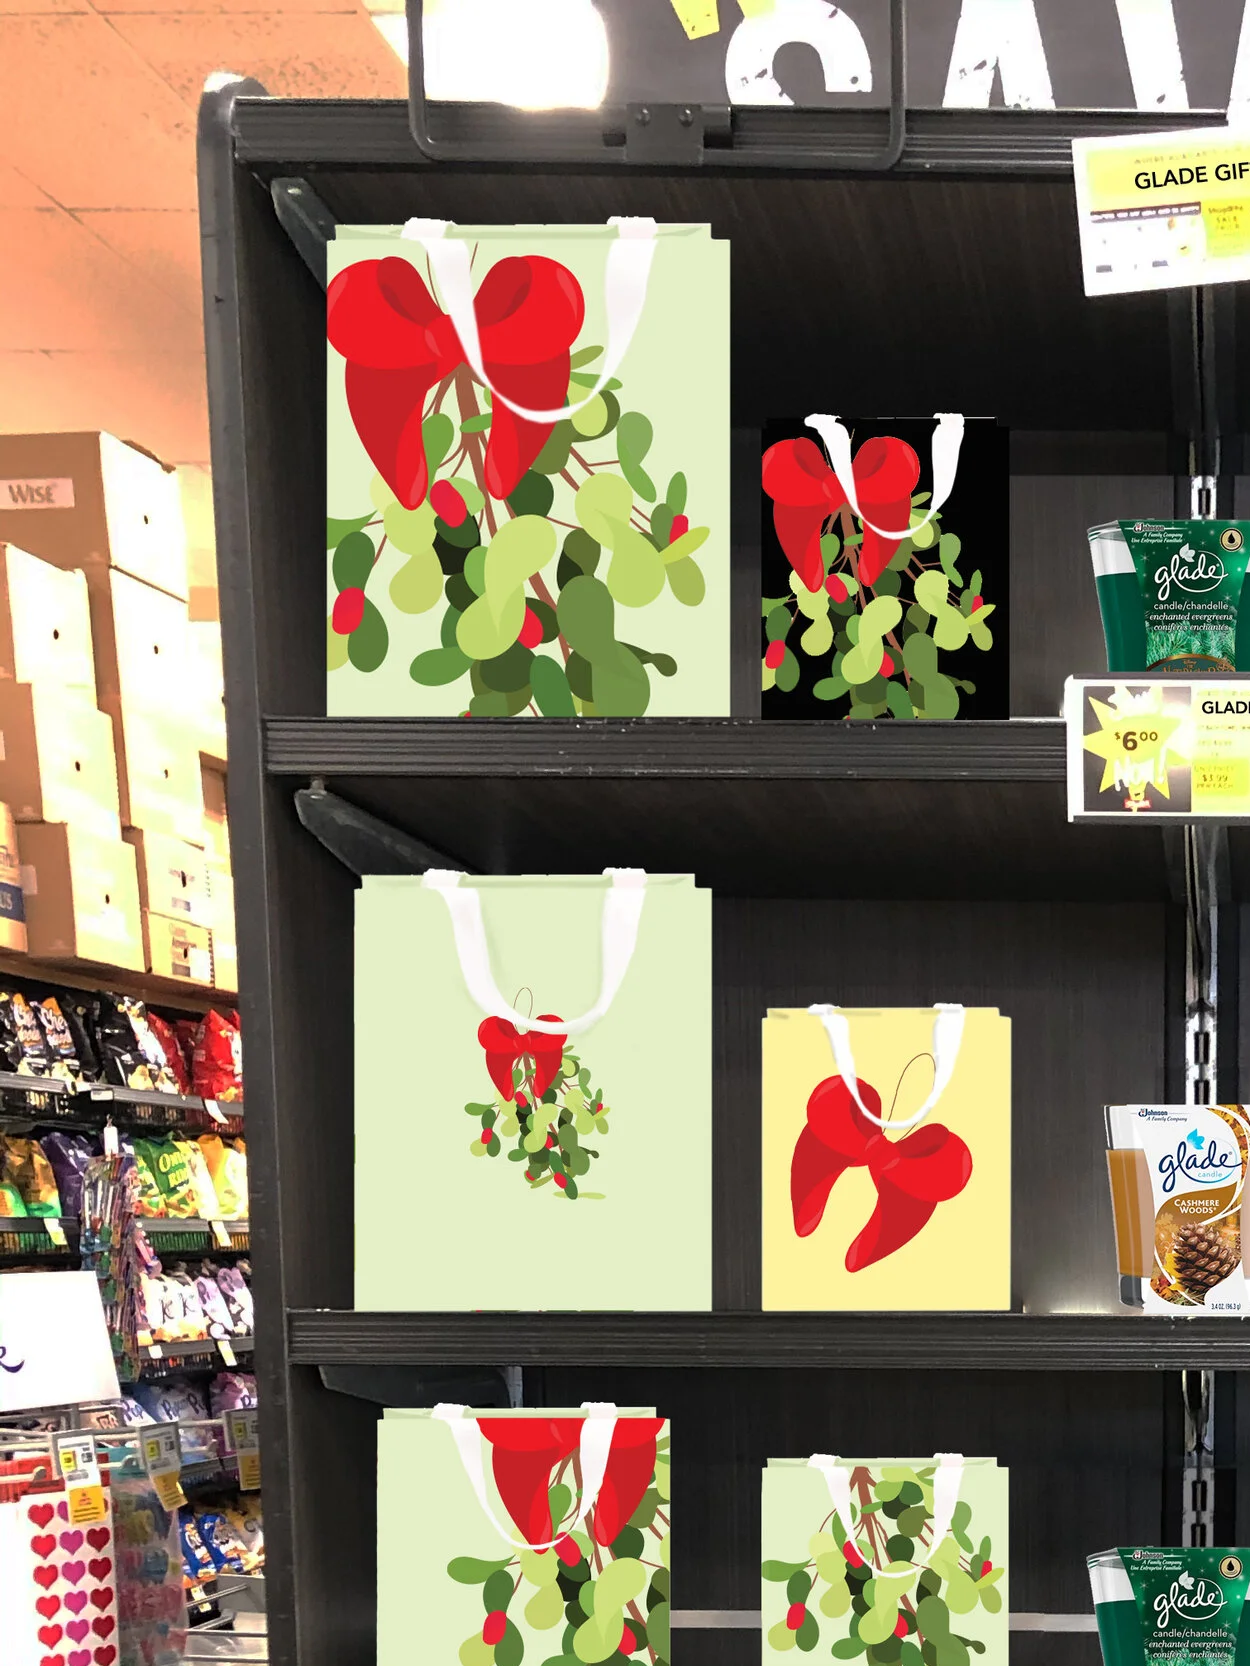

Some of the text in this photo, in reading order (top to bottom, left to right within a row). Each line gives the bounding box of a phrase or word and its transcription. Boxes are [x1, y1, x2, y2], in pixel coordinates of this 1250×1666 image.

[1135, 166, 1208, 190] GLADE
[8, 484, 56, 504] WISE
[1155, 553, 1229, 601] glade
[1154, 601, 1229, 610] candle/chandelle
[1150, 612, 1233, 622] enchanted evergreens
[1158, 1140, 1243, 1193] glade
[1174, 1199, 1220, 1207] CASHMERE
[1153, 1581, 1228, 1629] glade
[1153, 1629, 1228, 1638] candle/chandelle
[1148, 1640, 1232, 1650] enchanted evergreens
